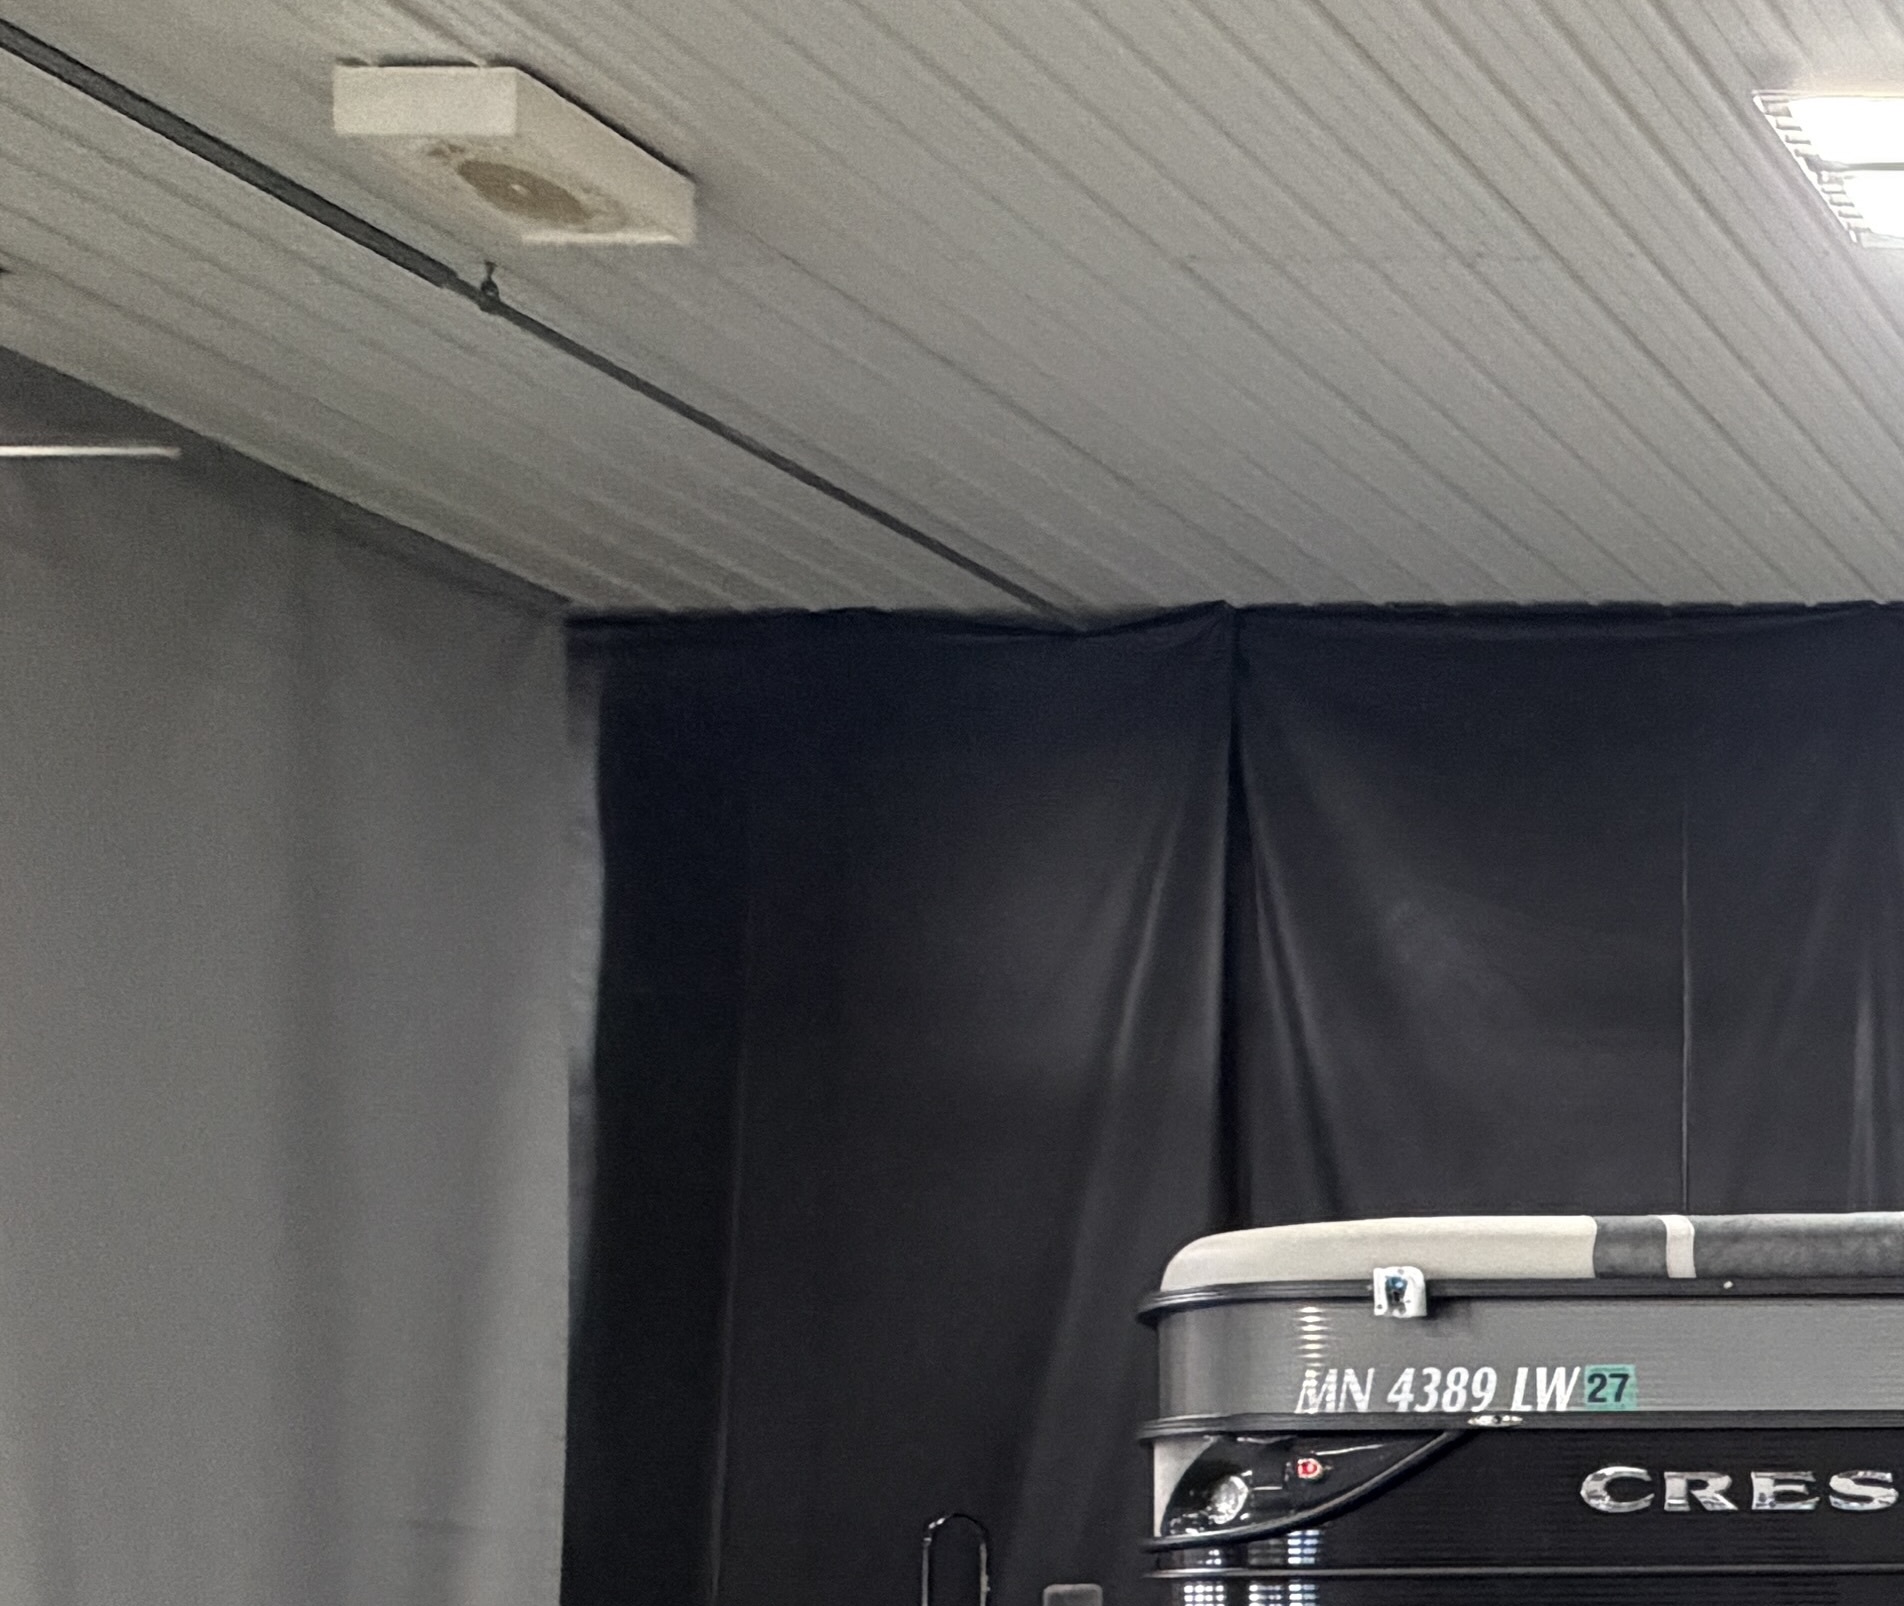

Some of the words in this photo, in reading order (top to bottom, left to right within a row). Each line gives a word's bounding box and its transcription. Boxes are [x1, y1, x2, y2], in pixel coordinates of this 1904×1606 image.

[1294, 1367, 1375, 1414] MN
[1386, 1366, 1498, 1413] 4389
[1510, 1366, 1581, 1412] LW
[1587, 1373, 1630, 1403] 27
